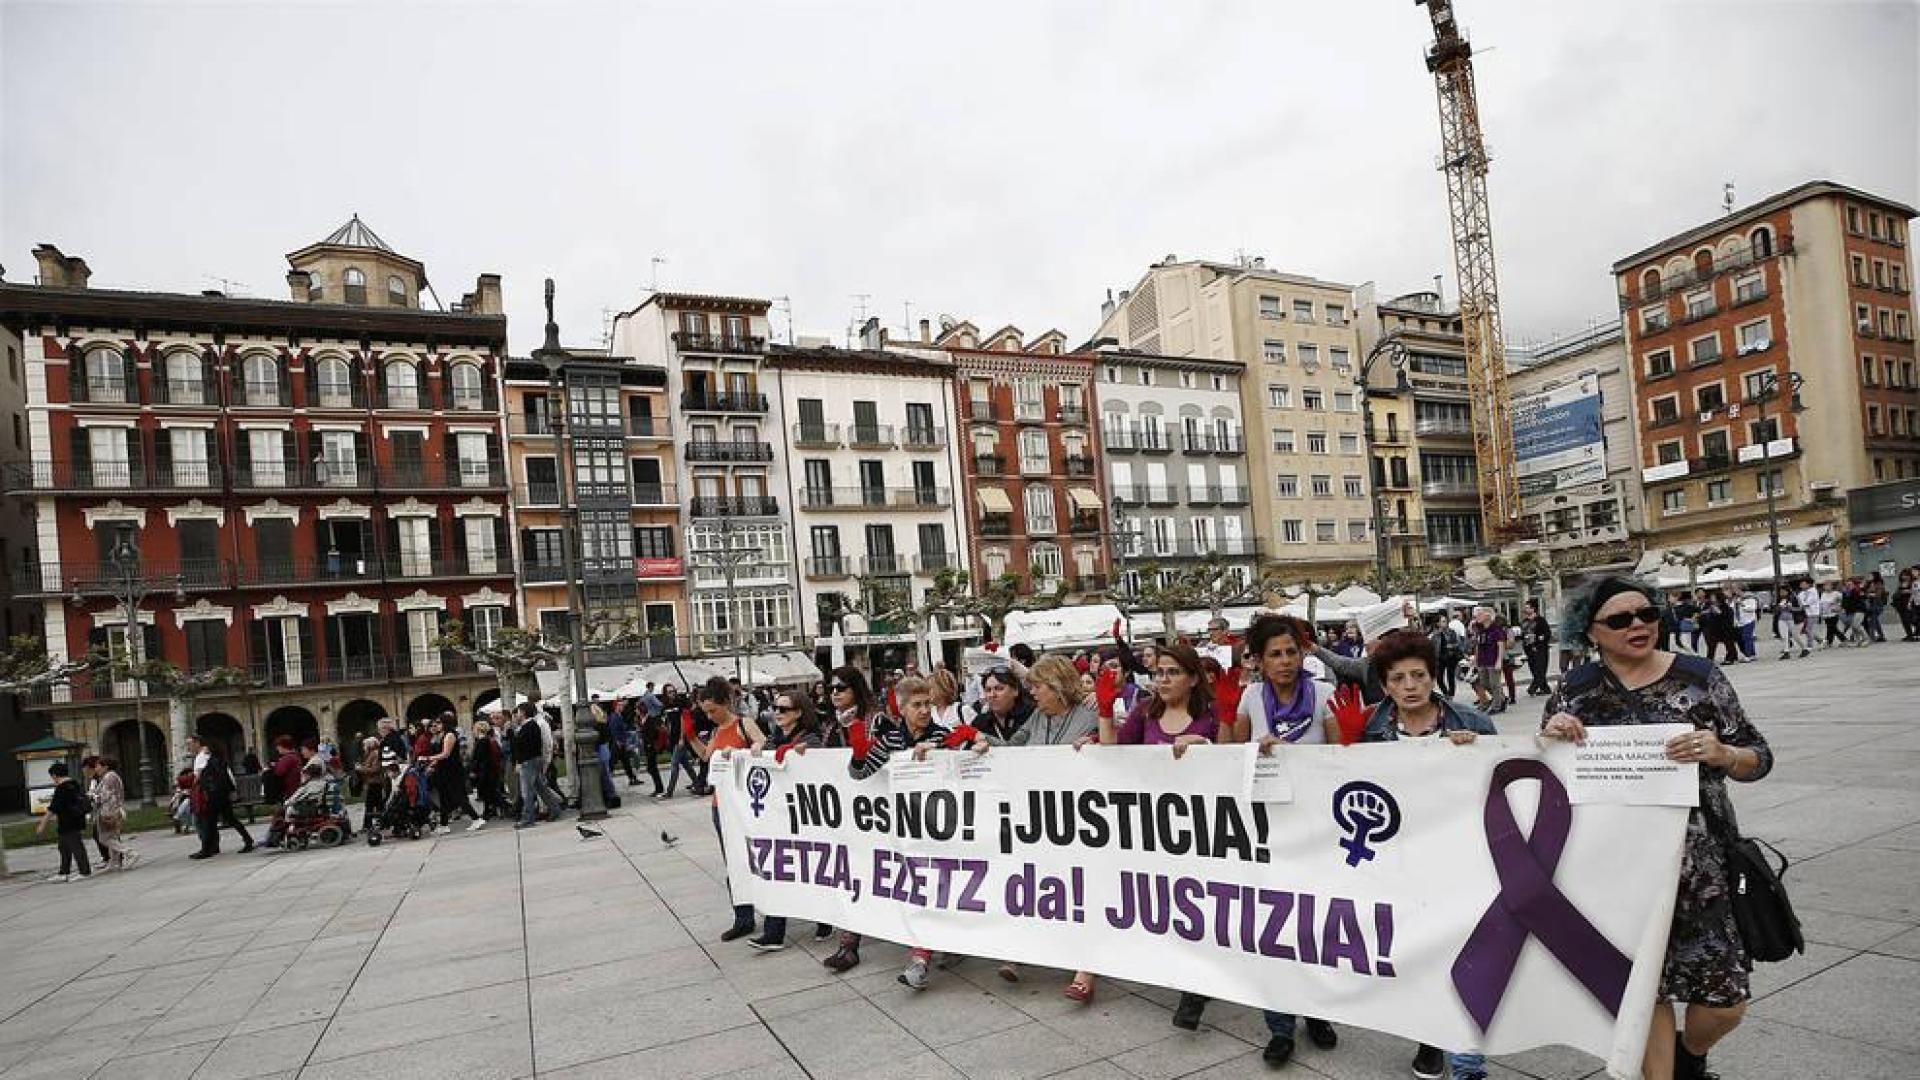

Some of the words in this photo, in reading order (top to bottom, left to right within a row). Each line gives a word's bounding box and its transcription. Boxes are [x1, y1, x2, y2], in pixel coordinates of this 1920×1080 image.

[786, 783, 842, 834] ¡NO
[853, 795, 891, 833] es
[896, 789, 976, 842] NO!
[999, 789, 1271, 864] ¡JUSTICIA!
[872, 848, 989, 913] EZETZ
[1004, 862, 1085, 924] da!
[1105, 870, 1397, 977] JUSTIZIA!
